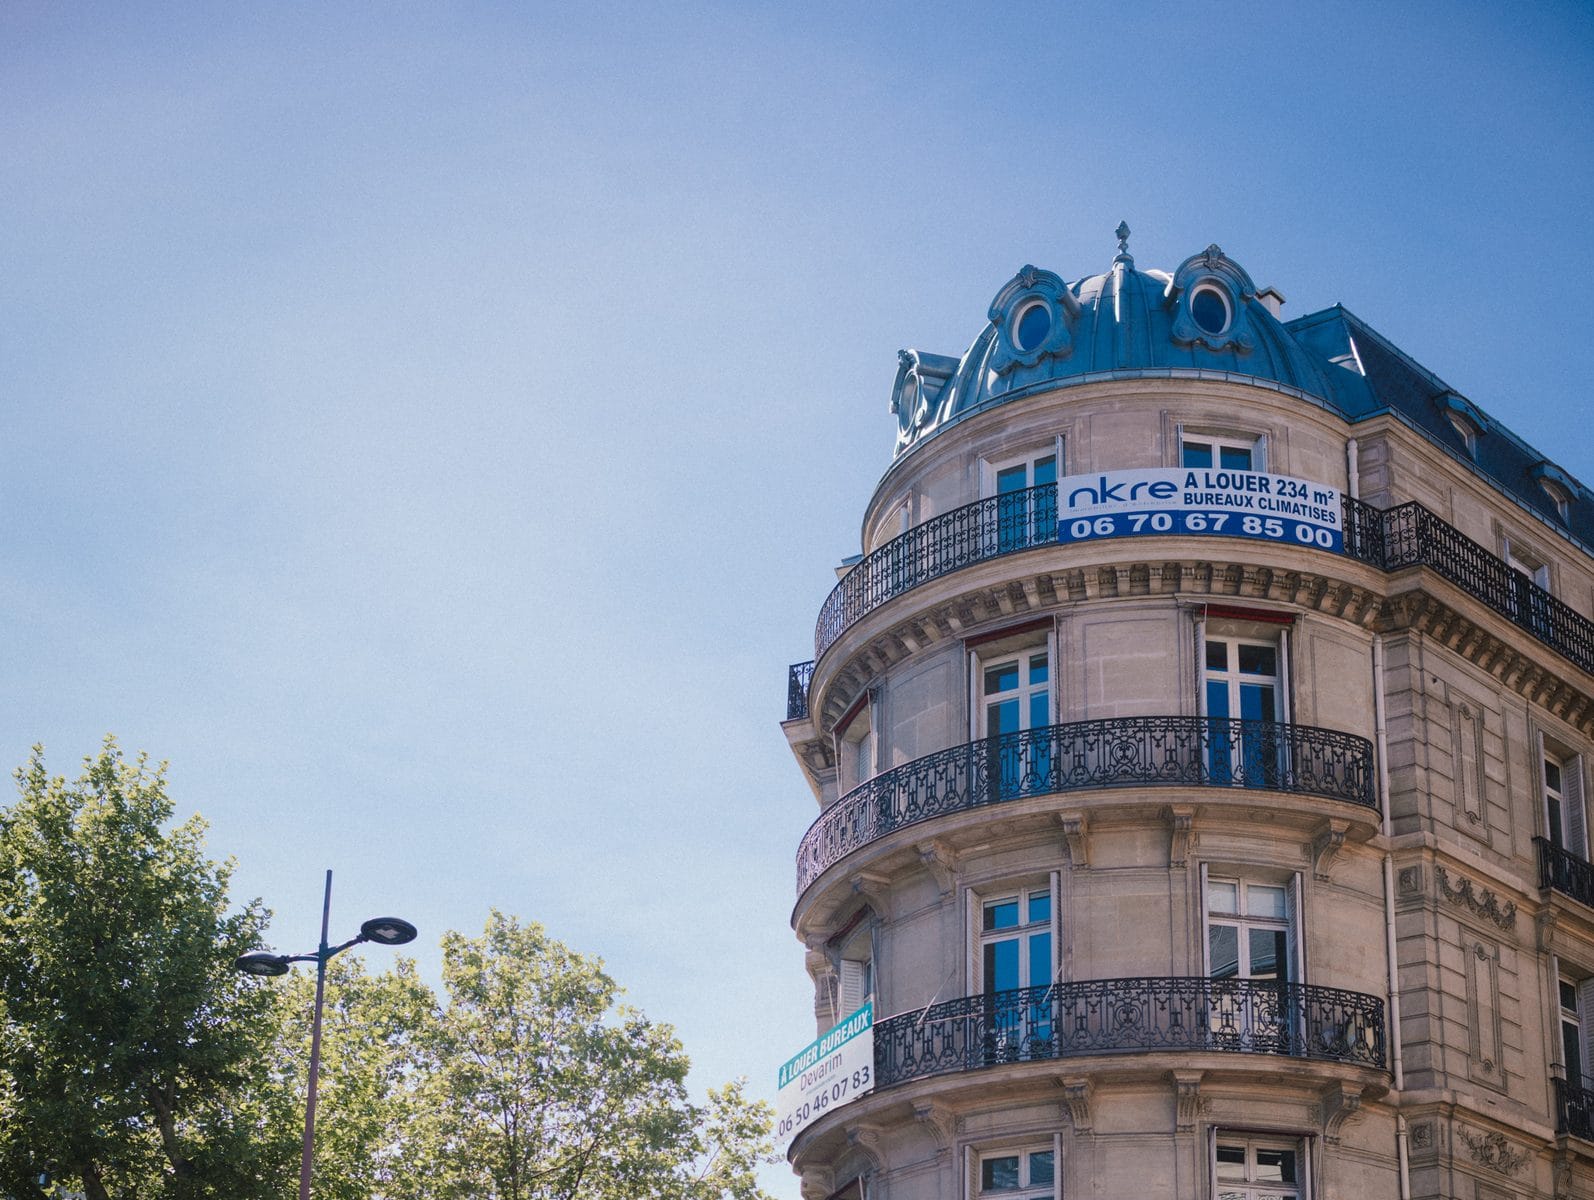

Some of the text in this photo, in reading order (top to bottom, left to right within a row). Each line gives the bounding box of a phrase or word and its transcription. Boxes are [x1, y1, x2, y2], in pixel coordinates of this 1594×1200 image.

[1069, 476, 1178, 508] nkre
[1184, 472, 1198, 489] A
[1204, 472, 1269, 495] LOUER
[1277, 478, 1308, 502] 234
[1183, 491, 1254, 509] BUREAUX
[1258, 497, 1337, 524] CLIMATISES
[1070, 513, 1334, 548] 06 70 67 85 00
[788, 1045, 818, 1080] LOUER
[819, 1009, 869, 1058] BUREAUX
[800, 1052, 843, 1092] Devarim
[779, 1065, 871, 1137] 06 50 46 07 83
